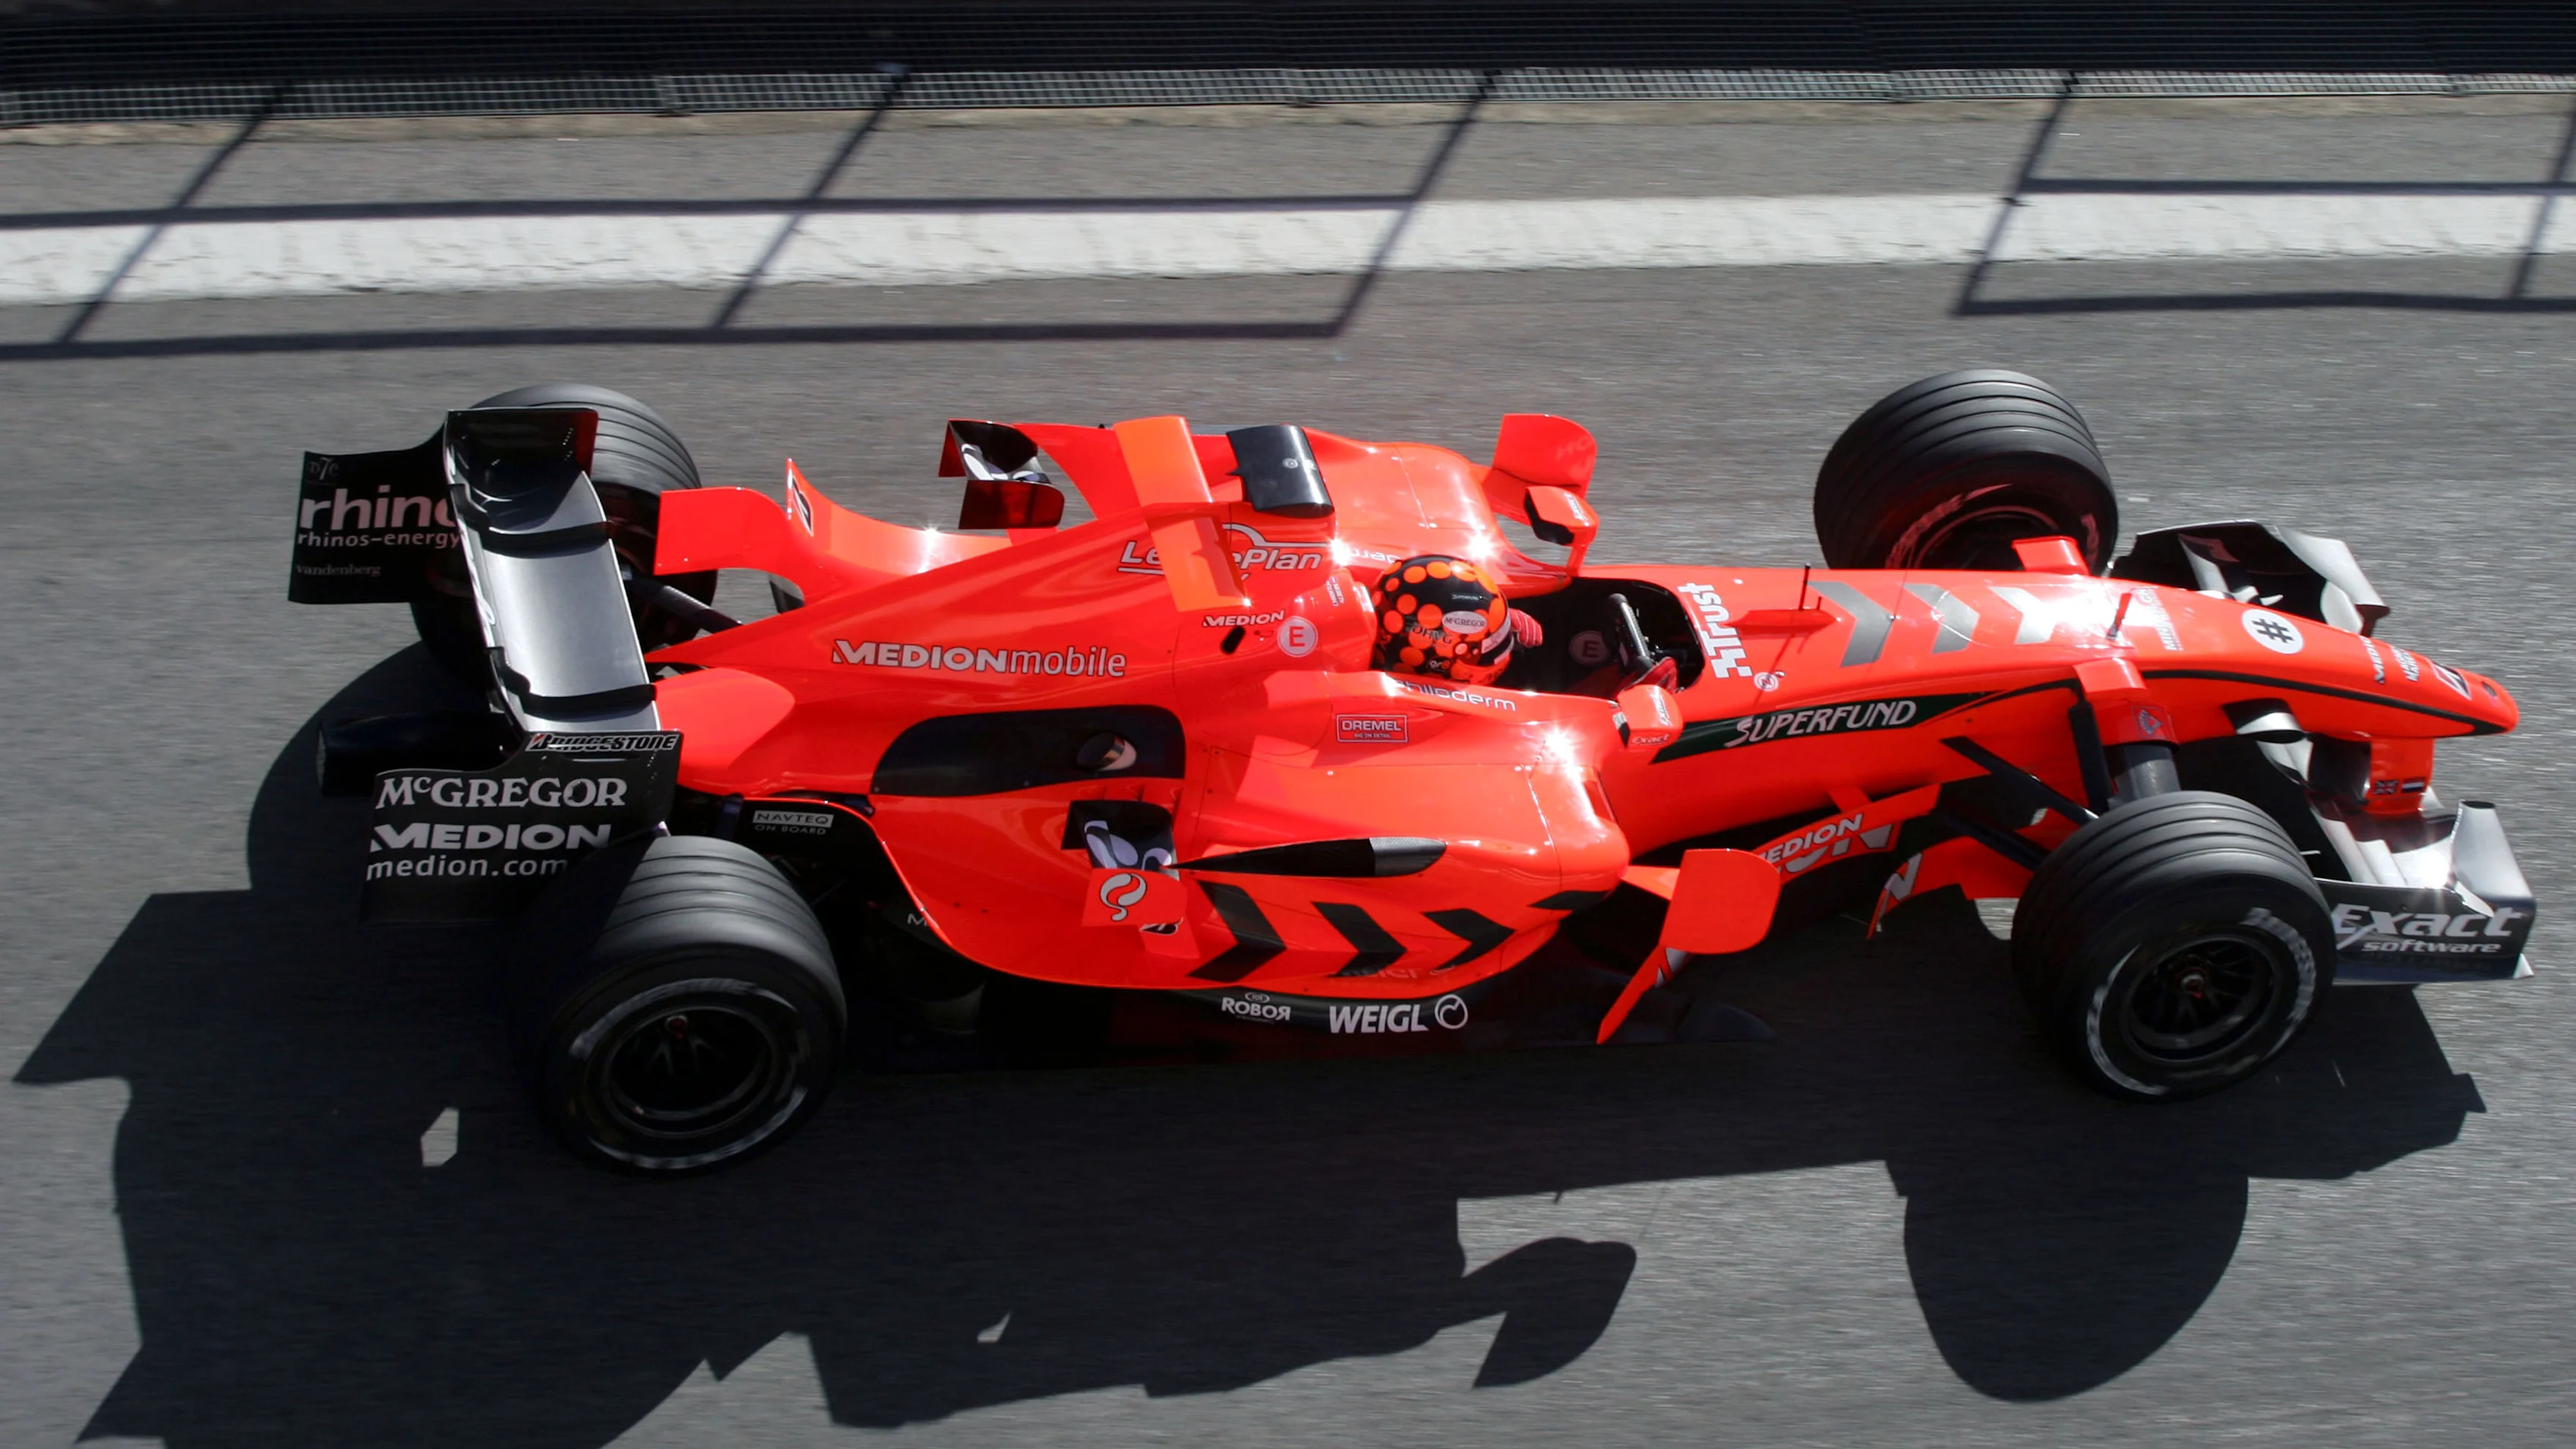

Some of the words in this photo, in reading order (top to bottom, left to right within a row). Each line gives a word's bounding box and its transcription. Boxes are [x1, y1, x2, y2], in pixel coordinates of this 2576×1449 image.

[297, 564, 381, 577] vandenberg
[1202, 610, 1285, 627] MEDION
[1678, 582, 1741, 657] Trust
[1290, 626, 1305, 647] E
[1341, 720, 1402, 731] DREMEL
[1724, 700, 1917, 748] SUPERFUND
[526, 734, 680, 751] BRIDGESTONE
[375, 777, 628, 810] McGREGOR
[757, 813, 829, 825] NAVTEQ
[781, 826, 827, 835] BOARD
[370, 822, 612, 853] MEDION
[1759, 813, 1863, 863] EDION
[366, 855, 569, 881] medion.com
[2331, 904, 2523, 949] Exact
[2361, 939, 2502, 953] software
[1329, 1004, 1429, 1034] WEIGL
